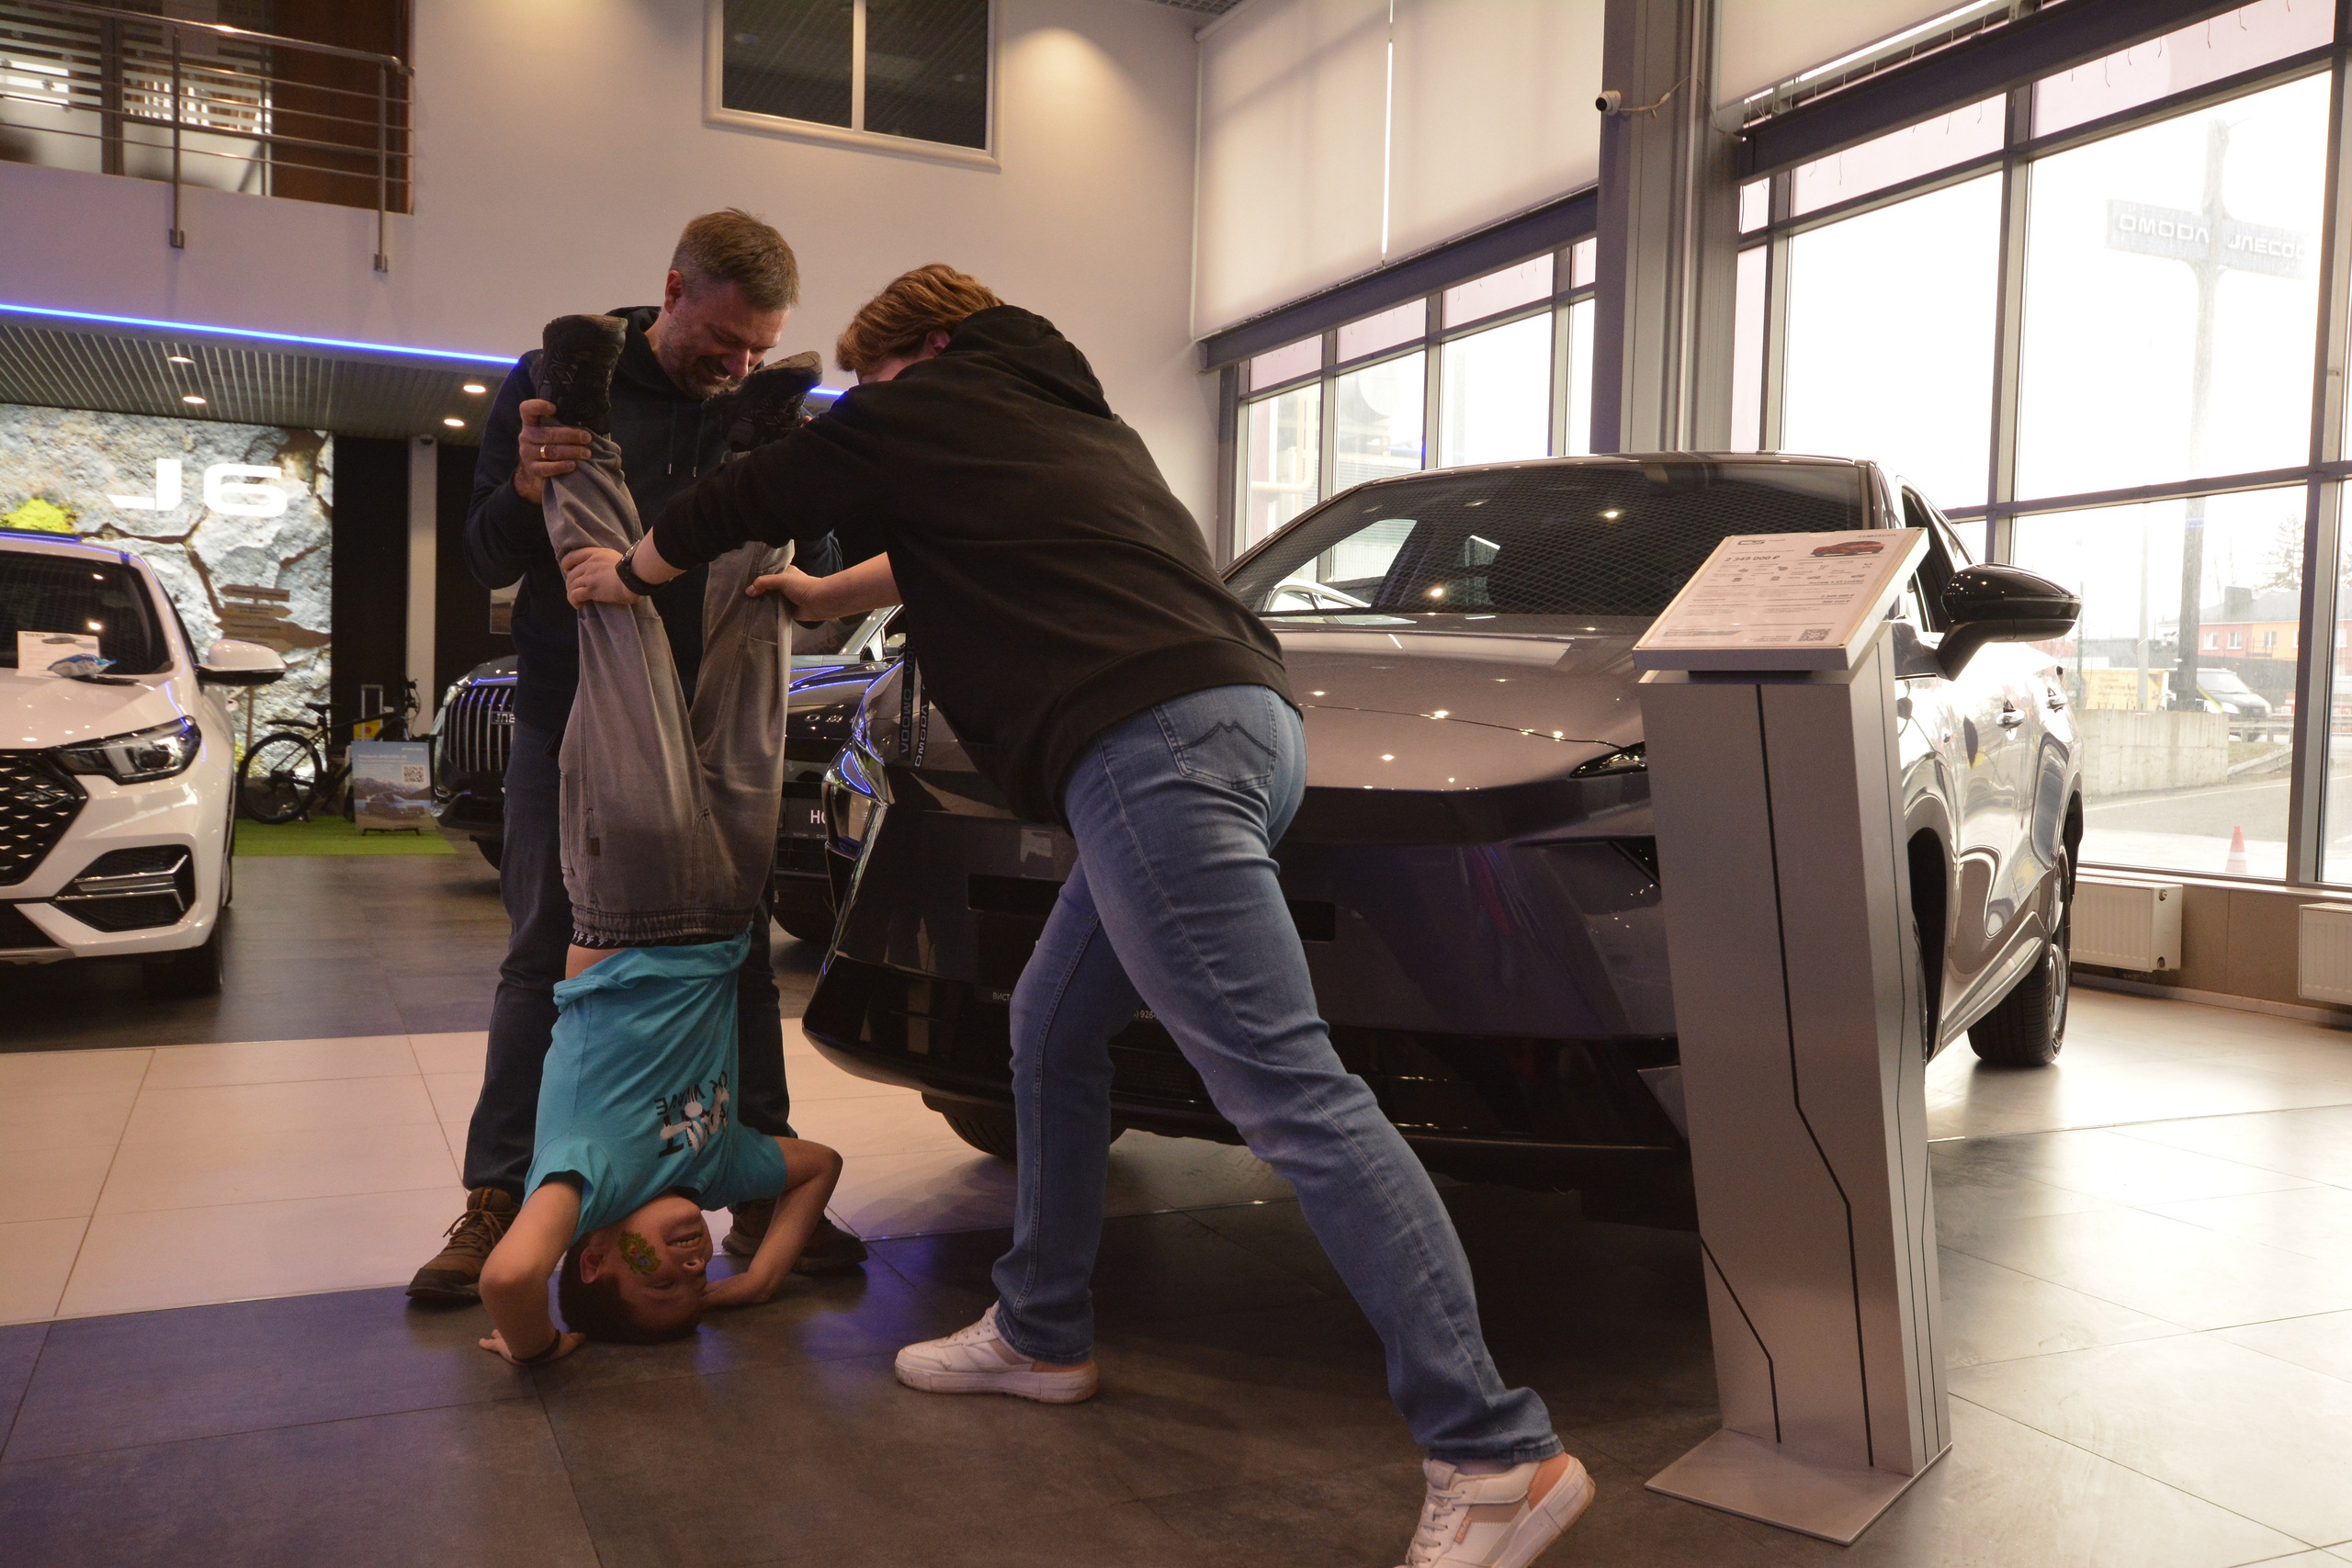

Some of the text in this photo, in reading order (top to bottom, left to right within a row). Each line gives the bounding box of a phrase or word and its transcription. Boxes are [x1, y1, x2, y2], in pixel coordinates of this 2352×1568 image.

[2119, 213, 2210, 244] OMODA
[2227, 232, 2307, 261] JAECOO
[899, 688, 911, 754] OMODA
[914, 704, 928, 768] OMODA
[992, 991, 1012, 1001] ВИСТ
